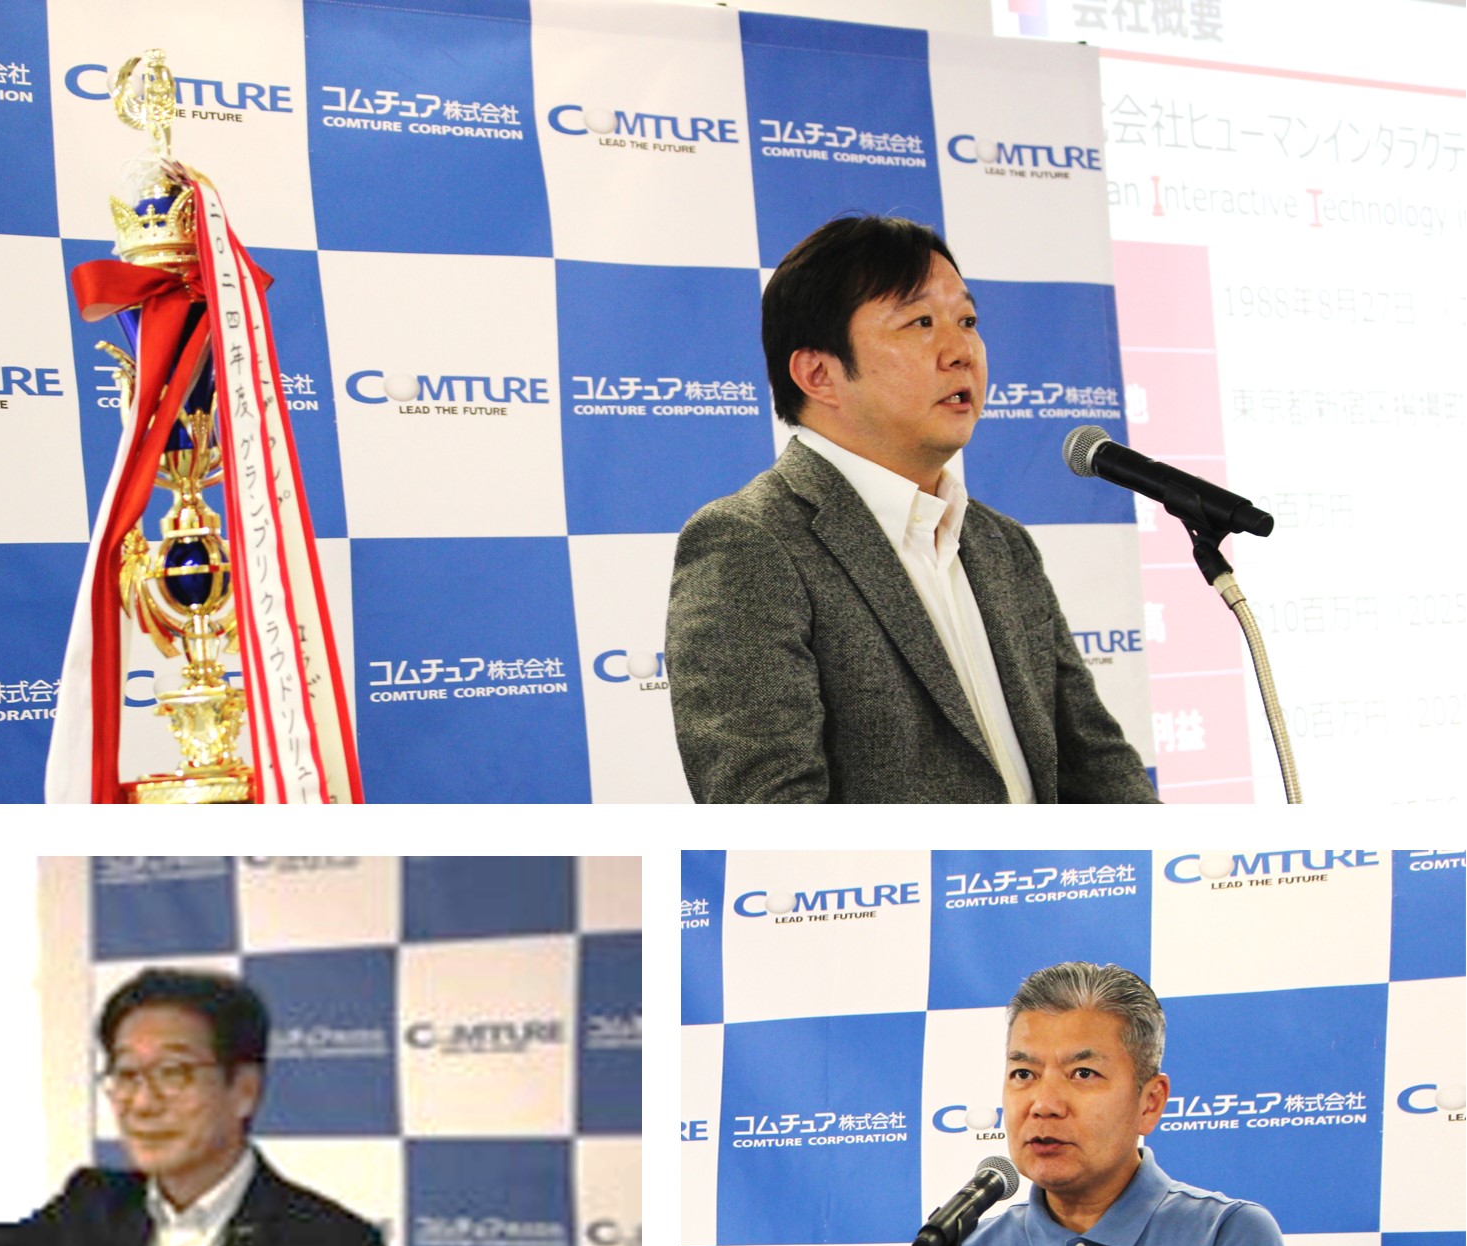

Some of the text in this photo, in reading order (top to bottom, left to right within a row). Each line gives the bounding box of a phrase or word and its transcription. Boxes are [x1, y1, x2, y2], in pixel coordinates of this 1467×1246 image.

[192, 111, 242, 122] FUTURE
[323, 116, 523, 139] COMTURE CORPORATION
[599, 138, 695, 153] LEAD THE FUTURE
[762, 147, 926, 167] COMTURE CORPORATION
[1031, 171, 1069, 179] FUTURE
[1151, 176, 1299, 218] Interactive
[1306, 189, 1446, 235] Technology
[399, 406, 507, 415] LEAD THE FUTURE
[574, 405, 759, 415] COMTURE CORPORATION
[1039, 409, 1120, 418] CORPORATION
[370, 683, 567, 702] COMTURE CORPORATION
[945, 863, 1136, 894] コムチュア株式会社
[1211, 873, 1328, 890] LEAD THE FUTURE
[945, 885, 1137, 910] COMTURE CORPORATION
[775, 908, 877, 925] LEAD THE FUTURE
[733, 1112, 906, 1136] コムチュア株式会社
[1160, 1114, 1366, 1131] COMTURE CORPORATION
[733, 1132, 907, 1149] COMTURE CORPORATION
